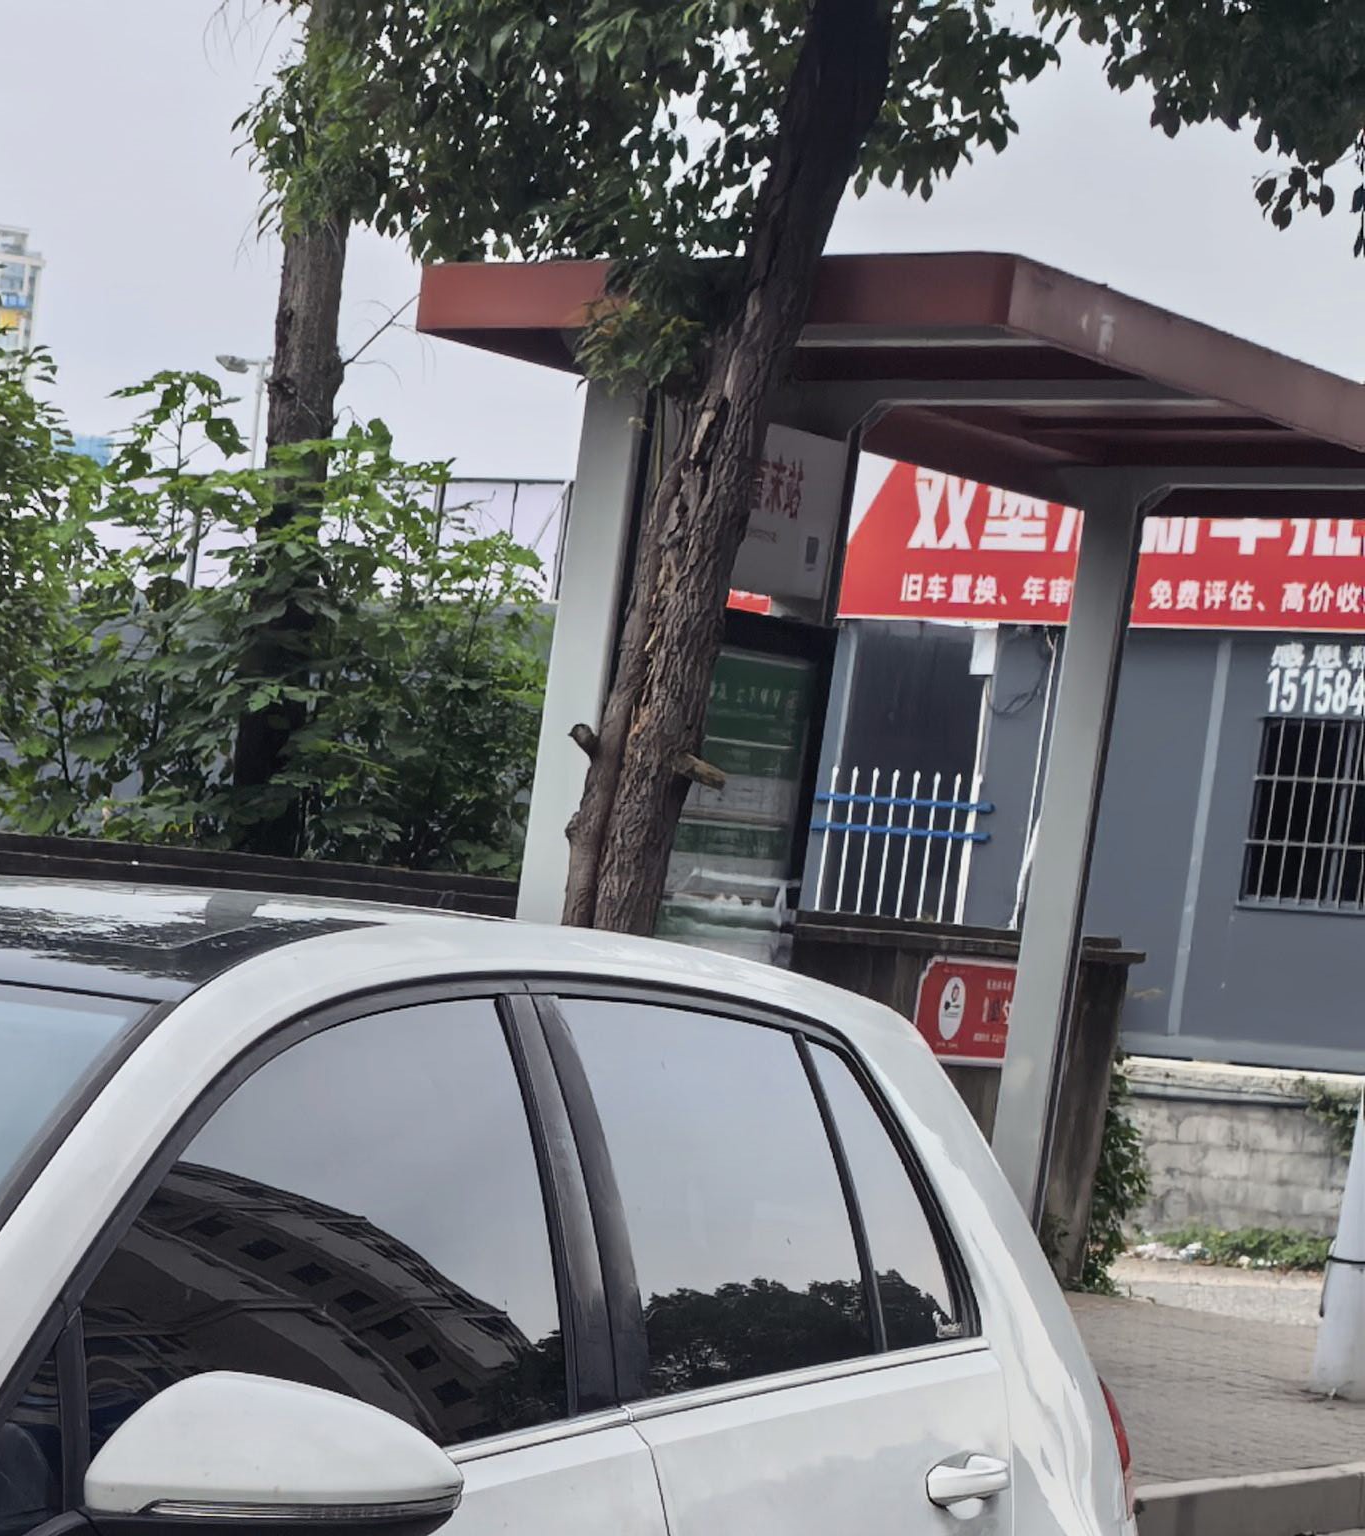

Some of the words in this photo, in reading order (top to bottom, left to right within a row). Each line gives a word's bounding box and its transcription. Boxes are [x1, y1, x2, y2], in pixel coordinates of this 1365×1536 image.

[907, 466, 1076, 552] 双堡
[1148, 578, 1365, 613] 免费评估、高价收
[1267, 667, 1365, 716] 151584
